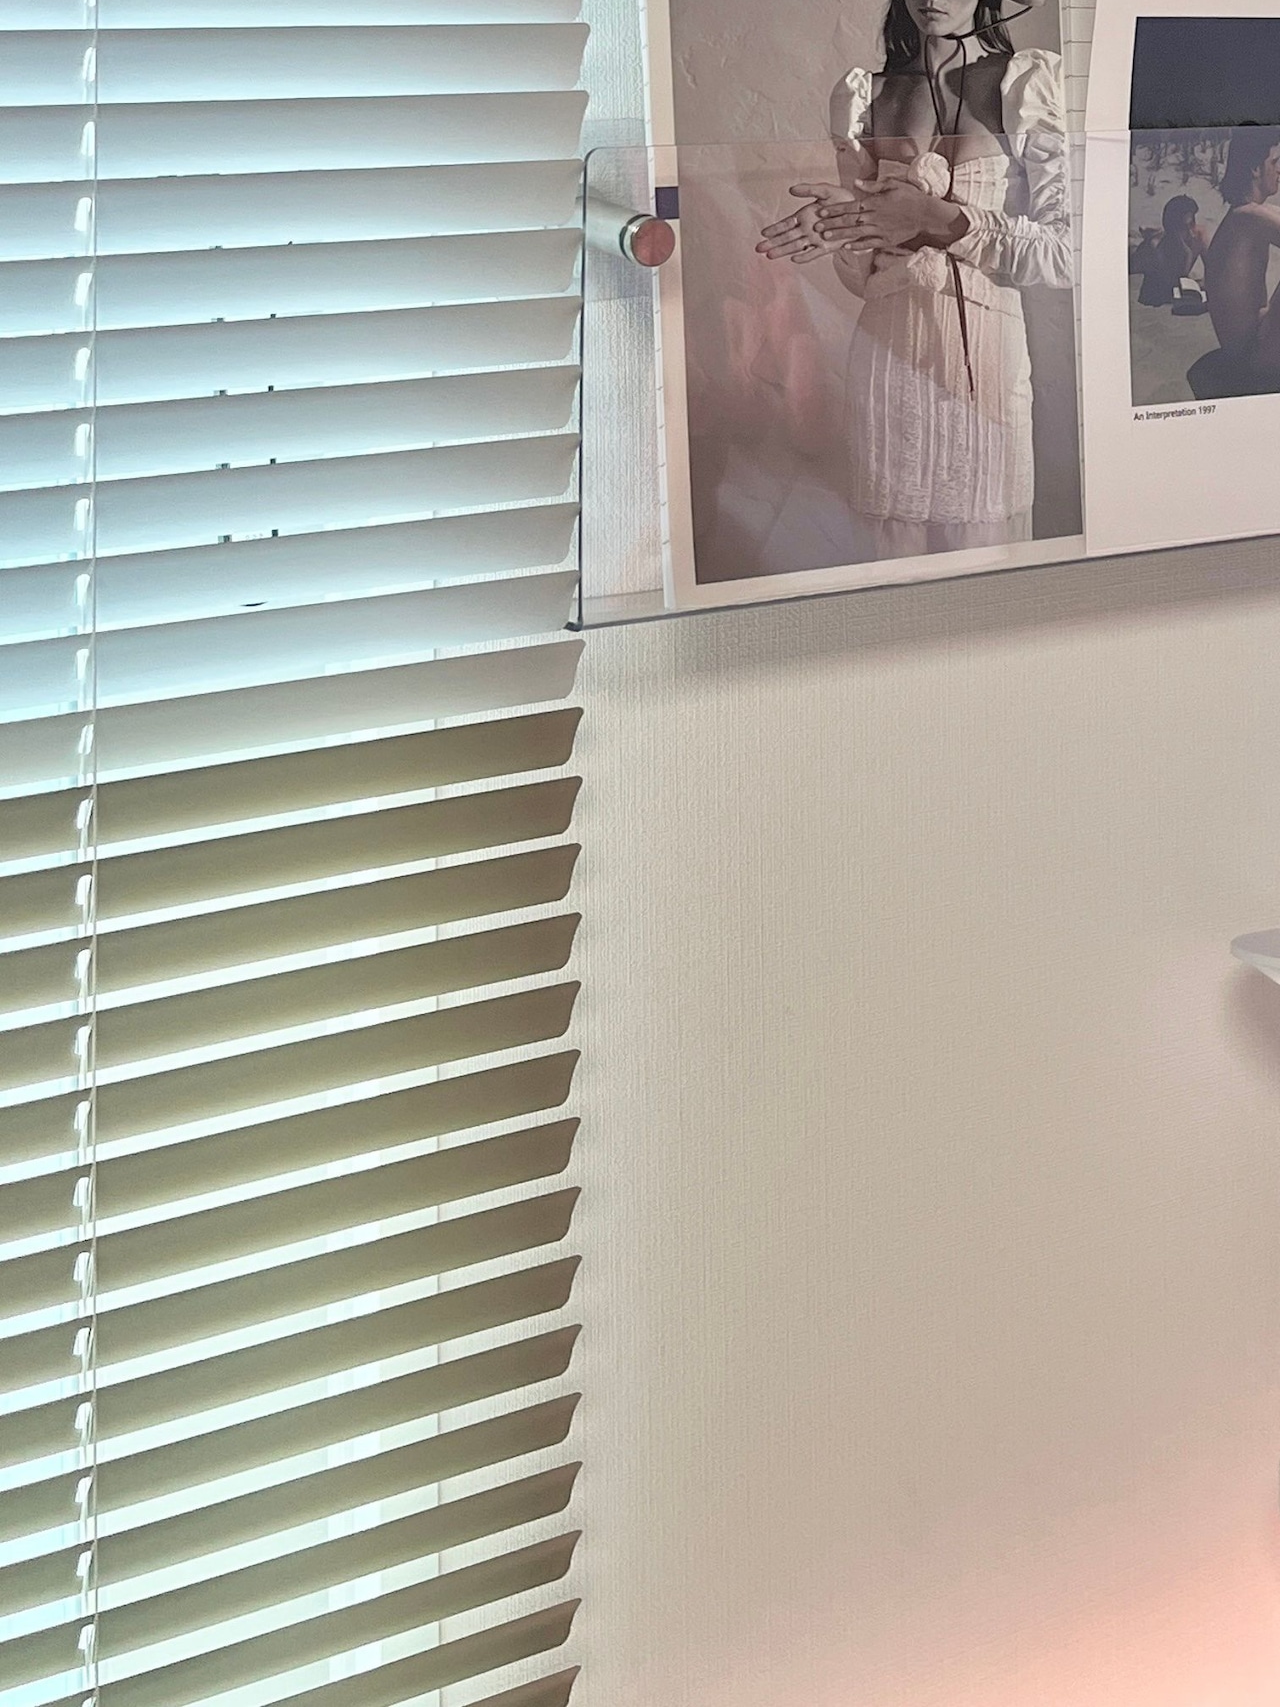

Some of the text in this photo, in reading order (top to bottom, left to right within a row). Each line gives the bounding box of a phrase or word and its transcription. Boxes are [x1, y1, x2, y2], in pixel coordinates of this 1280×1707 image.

[1133, 404, 1217, 422] An Interpretation 1997
